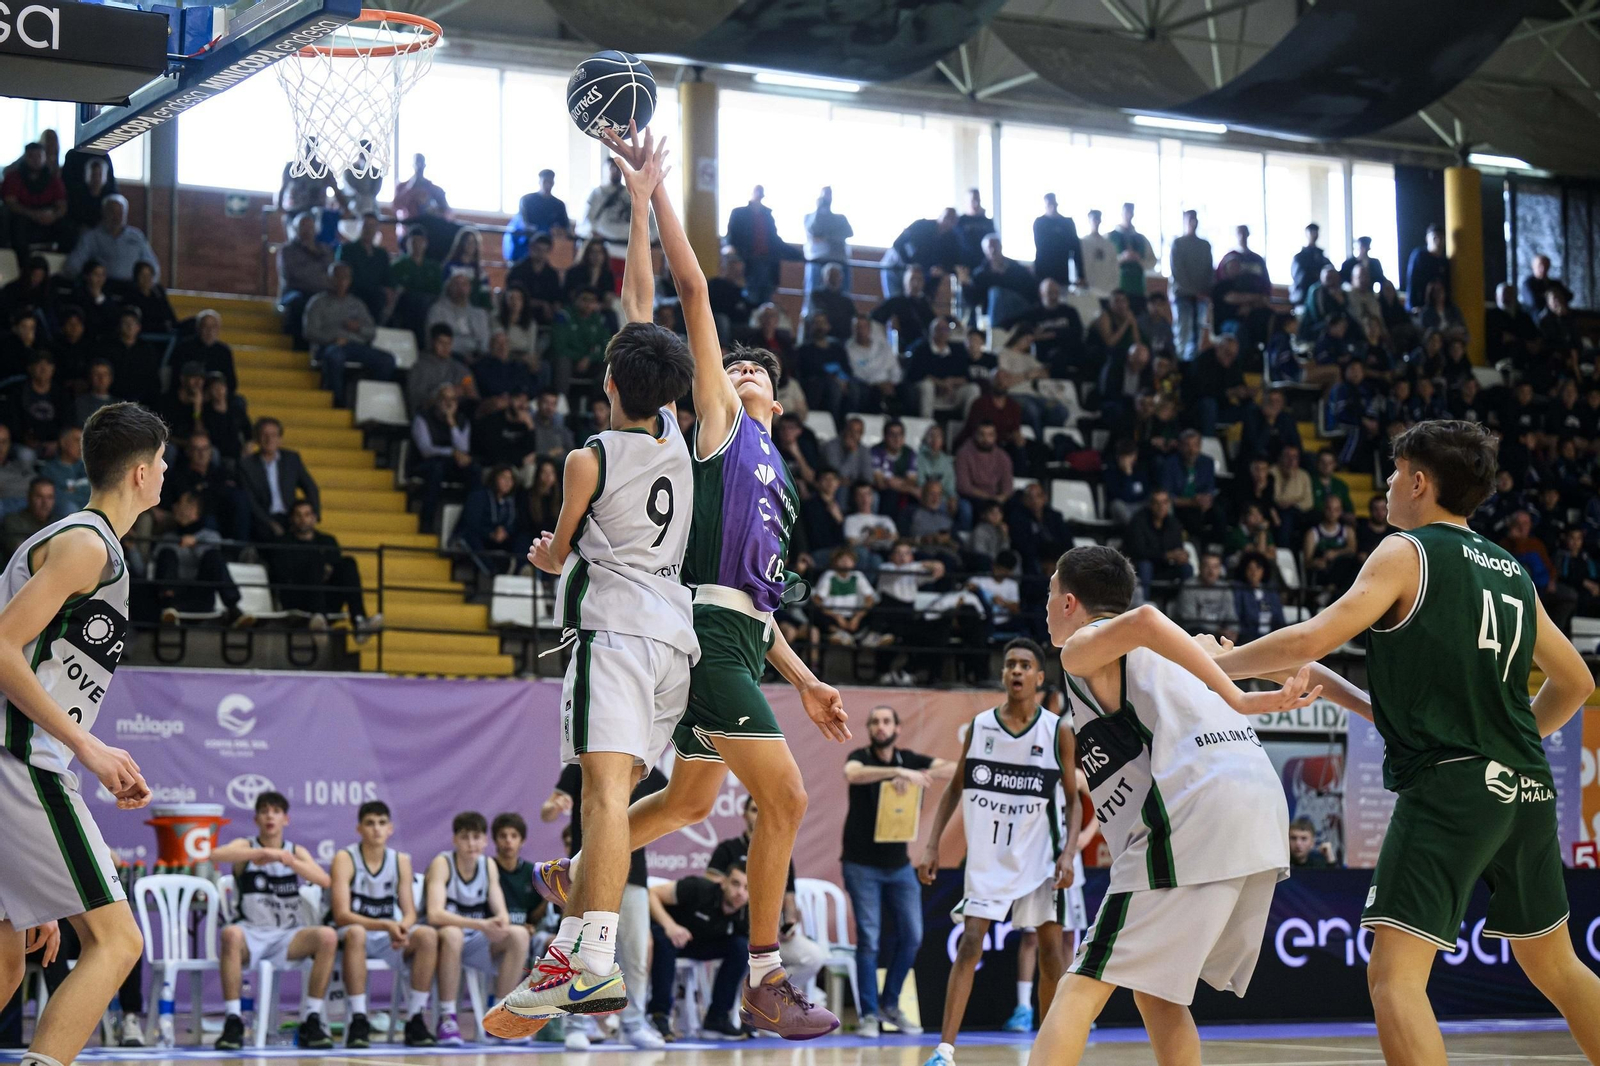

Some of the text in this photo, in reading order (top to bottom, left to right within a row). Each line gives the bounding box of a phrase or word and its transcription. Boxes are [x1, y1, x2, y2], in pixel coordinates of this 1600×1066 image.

[87, 20, 342, 151] MINICOPA endesa MINICOPA endesa
[645, 476, 674, 549] 9
[1478, 588, 1523, 682] 47
[63, 654, 105, 704] JOVE
[1194, 730, 1248, 748] BADALONA
[150, 784, 197, 804] icaja
[305, 780, 378, 805] IONOS
[993, 773, 1044, 793] PROBITAS
[970, 794, 1042, 815] JOVENTUT
[184, 827, 211, 858] G
[992, 821, 1014, 847] 11
